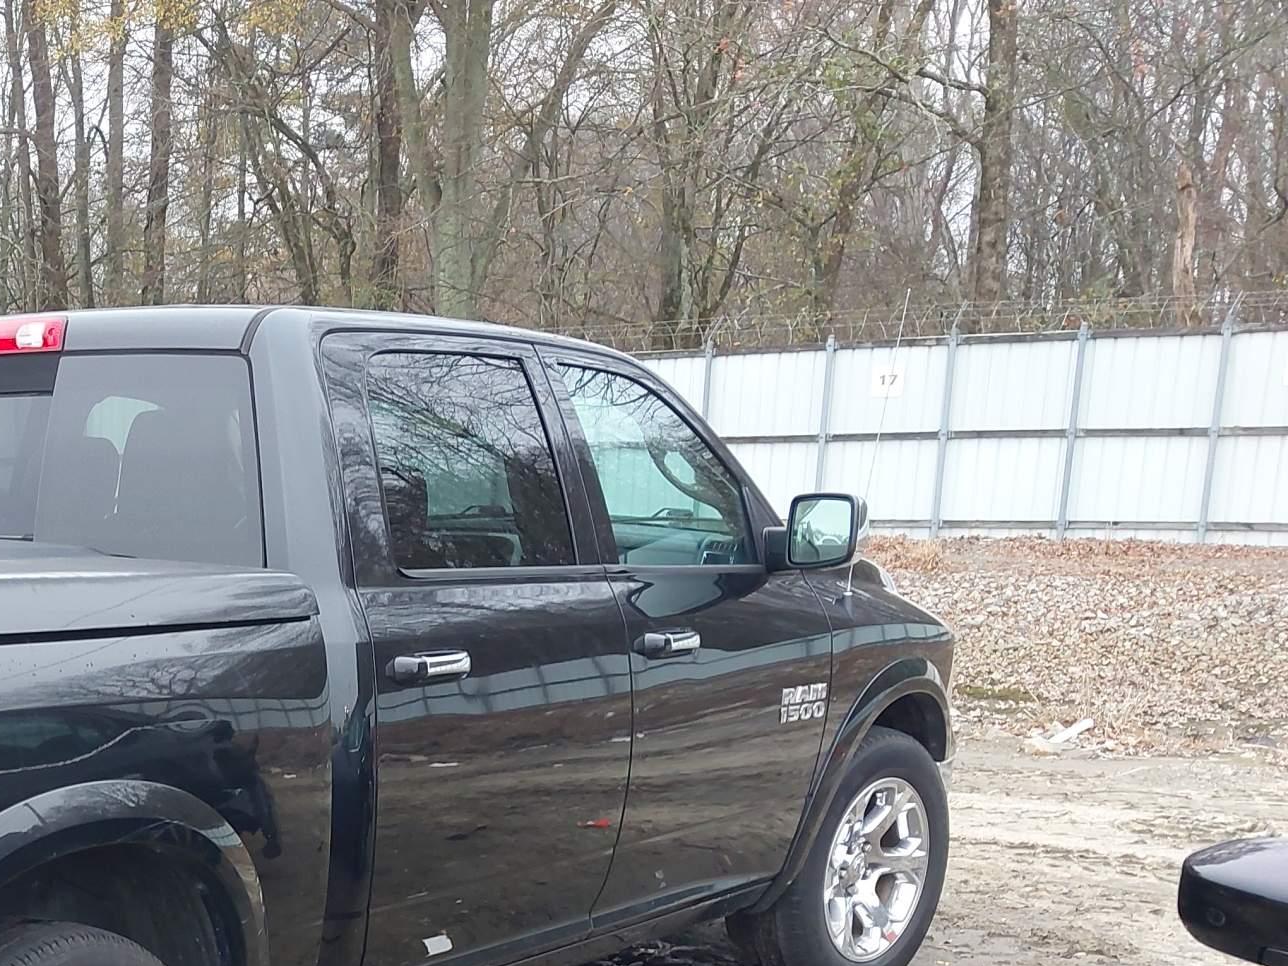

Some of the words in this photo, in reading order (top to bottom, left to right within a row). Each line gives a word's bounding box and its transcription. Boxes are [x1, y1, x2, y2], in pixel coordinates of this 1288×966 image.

[879, 374, 898, 385] 17
[781, 682, 827, 705] RAM
[780, 701, 825, 724] 1500
